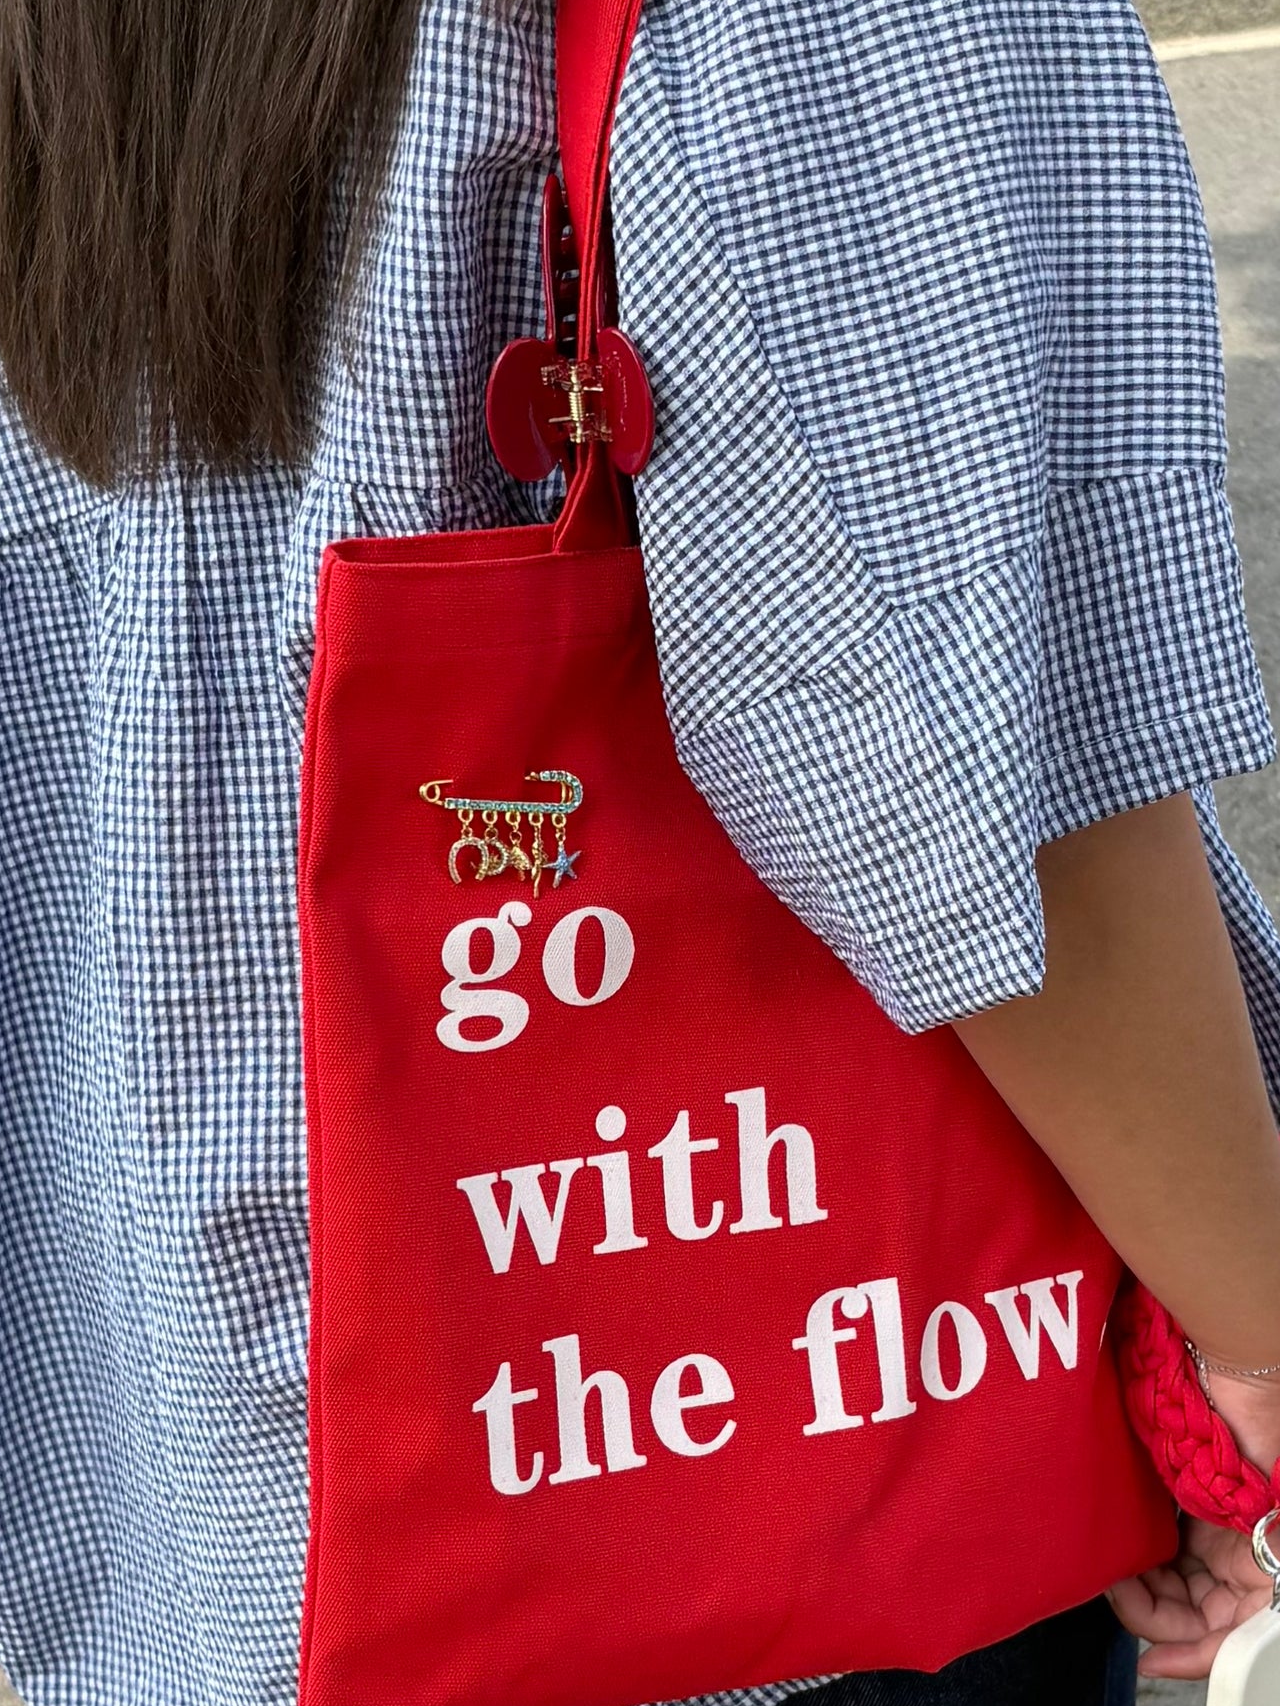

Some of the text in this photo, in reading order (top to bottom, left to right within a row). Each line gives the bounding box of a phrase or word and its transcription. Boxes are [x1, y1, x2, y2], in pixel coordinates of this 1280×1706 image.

[435, 900, 636, 1053] go
[456, 1086, 828, 1274] with
[472, 1270, 1084, 1496] the flow
